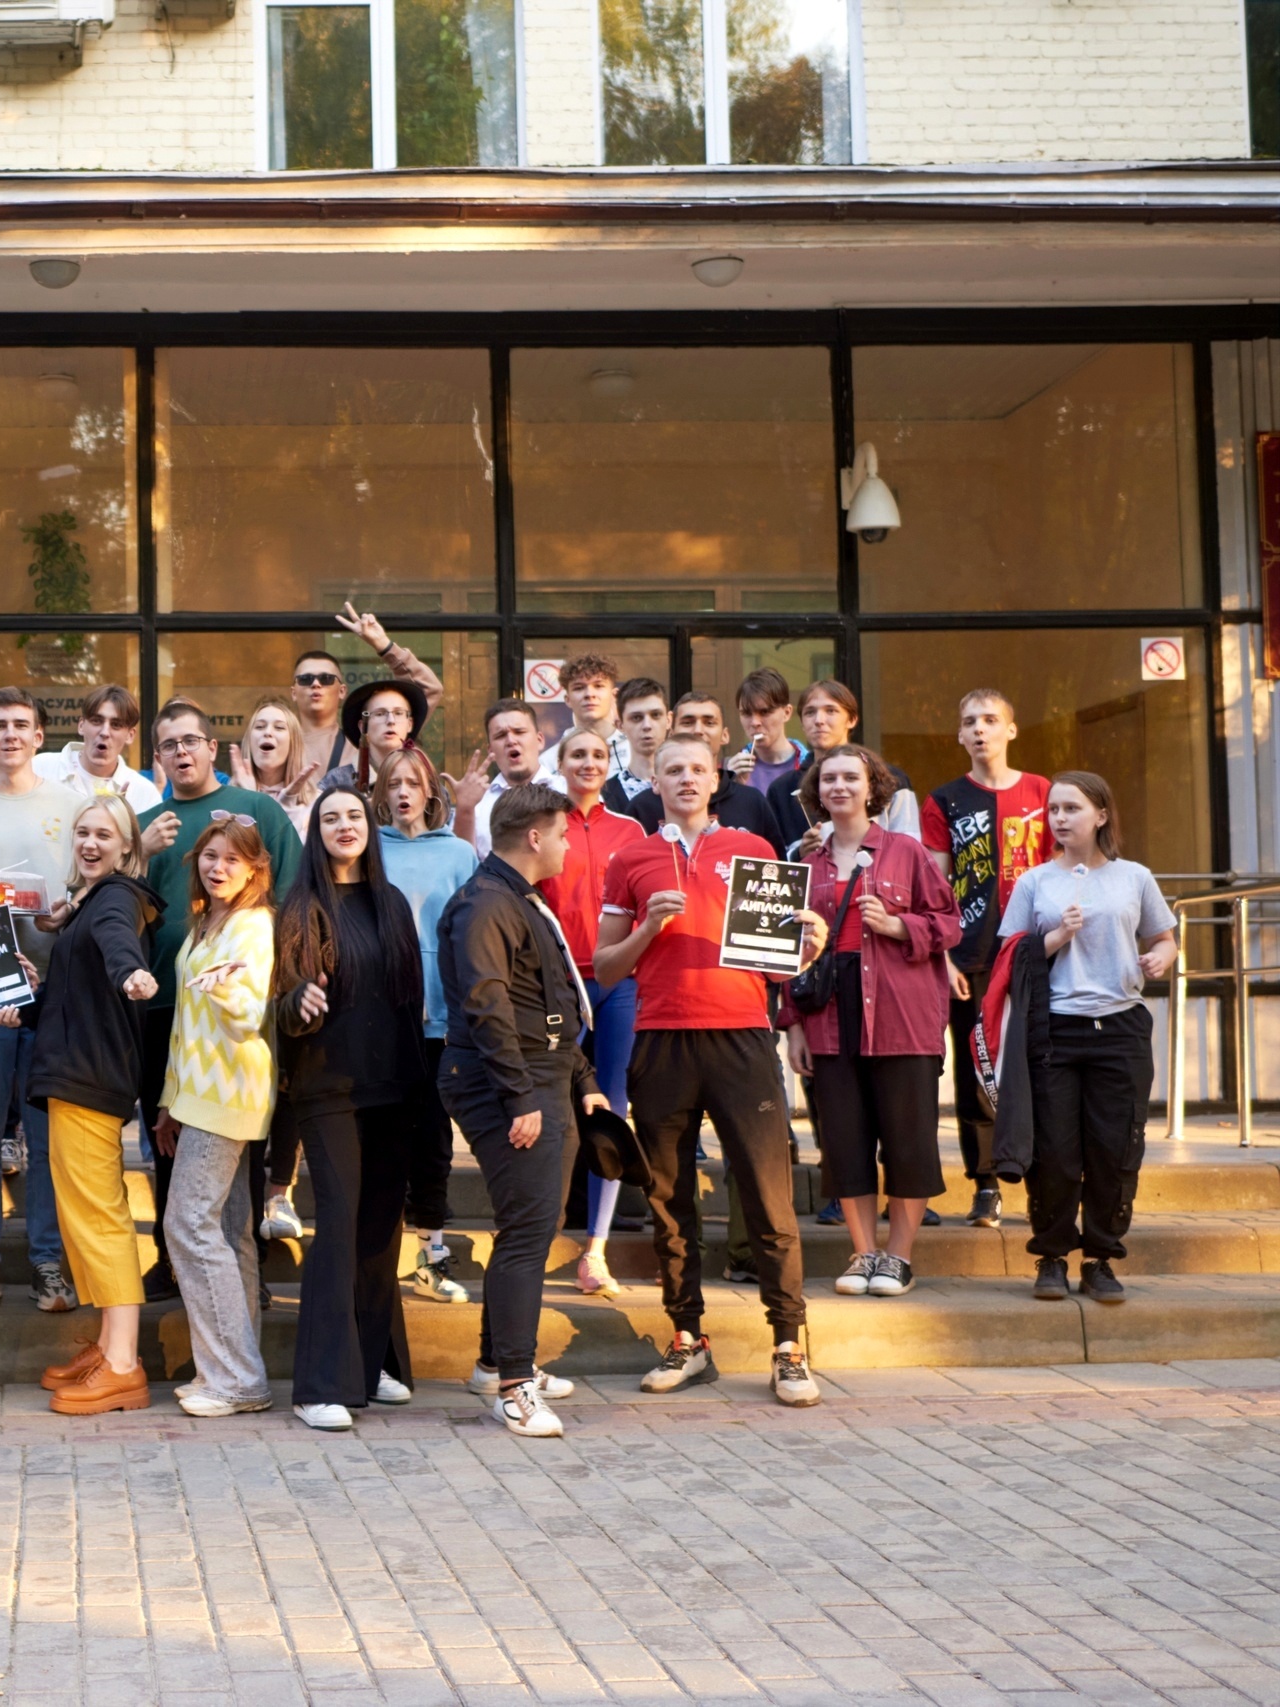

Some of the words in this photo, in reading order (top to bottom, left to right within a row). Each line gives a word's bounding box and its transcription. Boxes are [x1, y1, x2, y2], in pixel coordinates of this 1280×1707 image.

[745, 879, 791, 897] MAFIA
[739, 899, 794, 915] ДИПЛОМ
[760, 915, 769, 927] 3
[974, 1023, 989, 1061] RESPECT
[980, 1061, 993, 1077] ME
